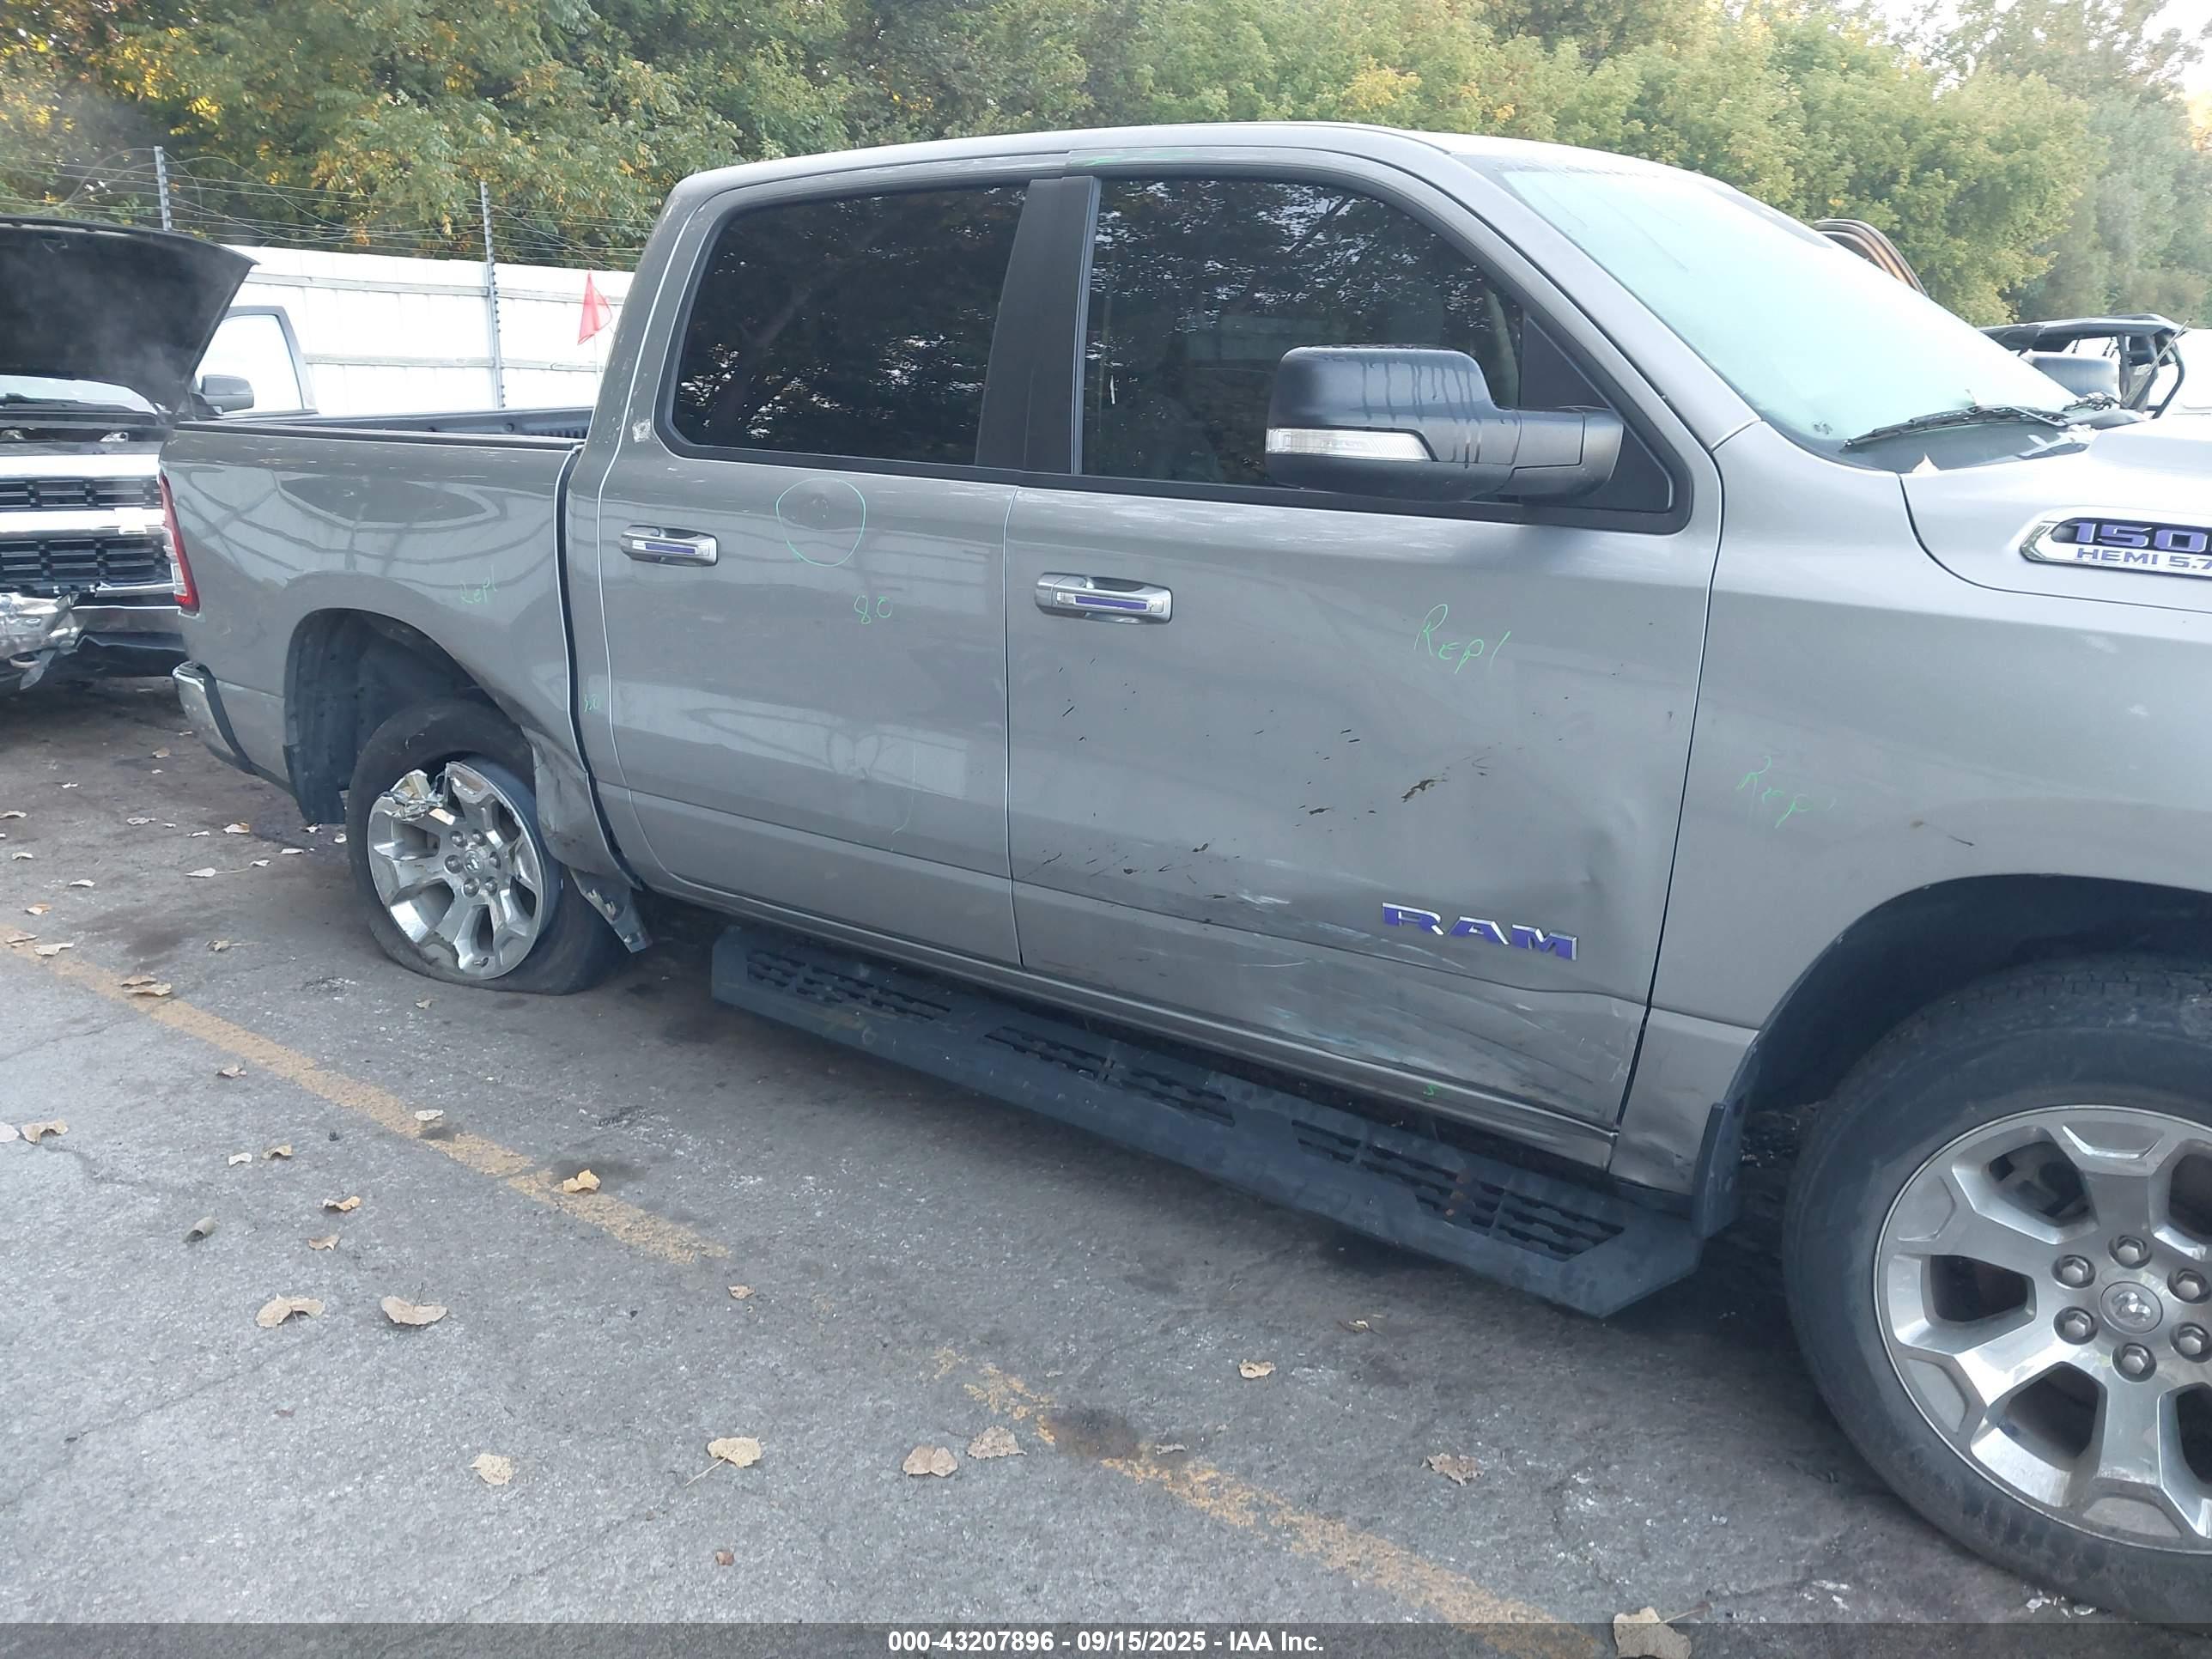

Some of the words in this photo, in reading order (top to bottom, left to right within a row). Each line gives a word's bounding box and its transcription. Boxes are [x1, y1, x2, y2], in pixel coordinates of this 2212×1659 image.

[2069, 522, 2212, 553] 150
[2076, 547, 2160, 566] HEMI
[1382, 902, 1577, 961] RAM
